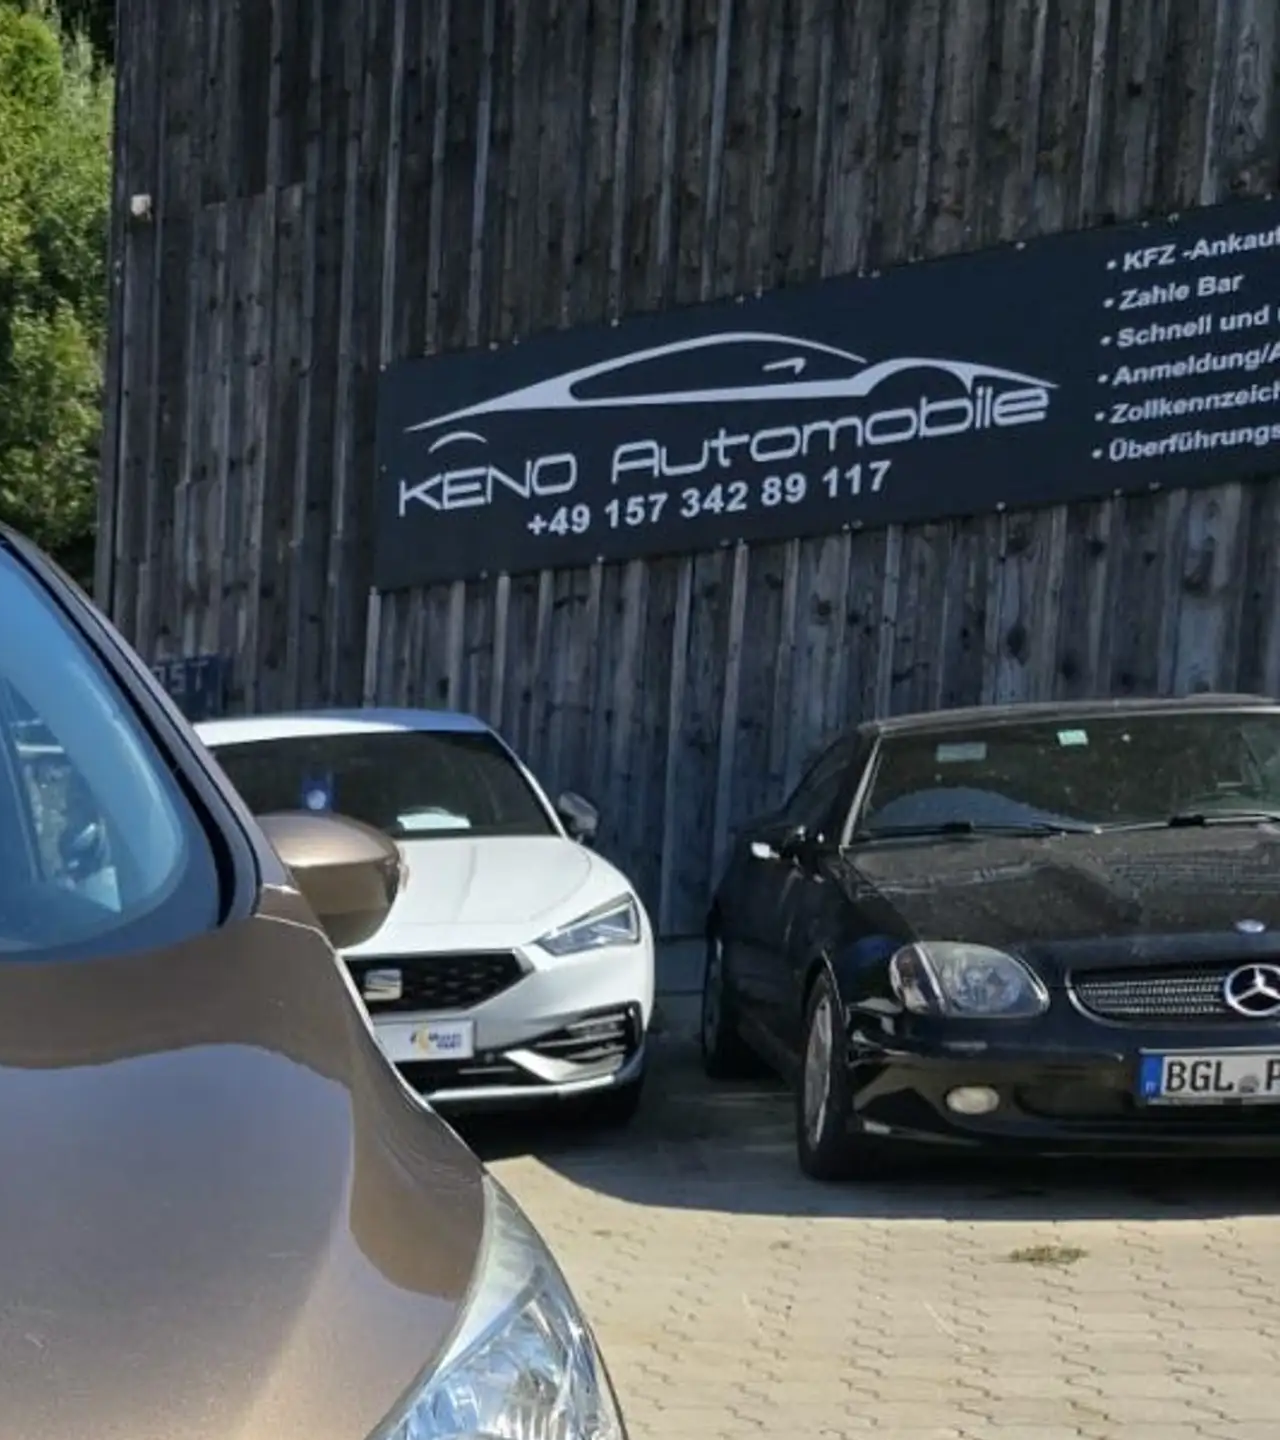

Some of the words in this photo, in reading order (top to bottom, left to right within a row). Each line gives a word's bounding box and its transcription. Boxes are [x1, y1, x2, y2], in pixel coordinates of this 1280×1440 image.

[1122, 243, 1176, 272] KFZ
[1118, 282, 1190, 310] Zahle
[1197, 274, 1245, 297] Bar
[1116, 313, 1212, 348] Schnell
[1219, 304, 1270, 332] und
[398, 452, 578, 517] KENO
[611, 386, 1049, 484] Automobile
[527, 503, 591, 536] +49
[604, 492, 668, 528] 157
[680, 480, 748, 519] 342
[761, 472, 807, 507] 89
[822, 460, 892, 498] 117
[1165, 1059, 1235, 1093] BGL
